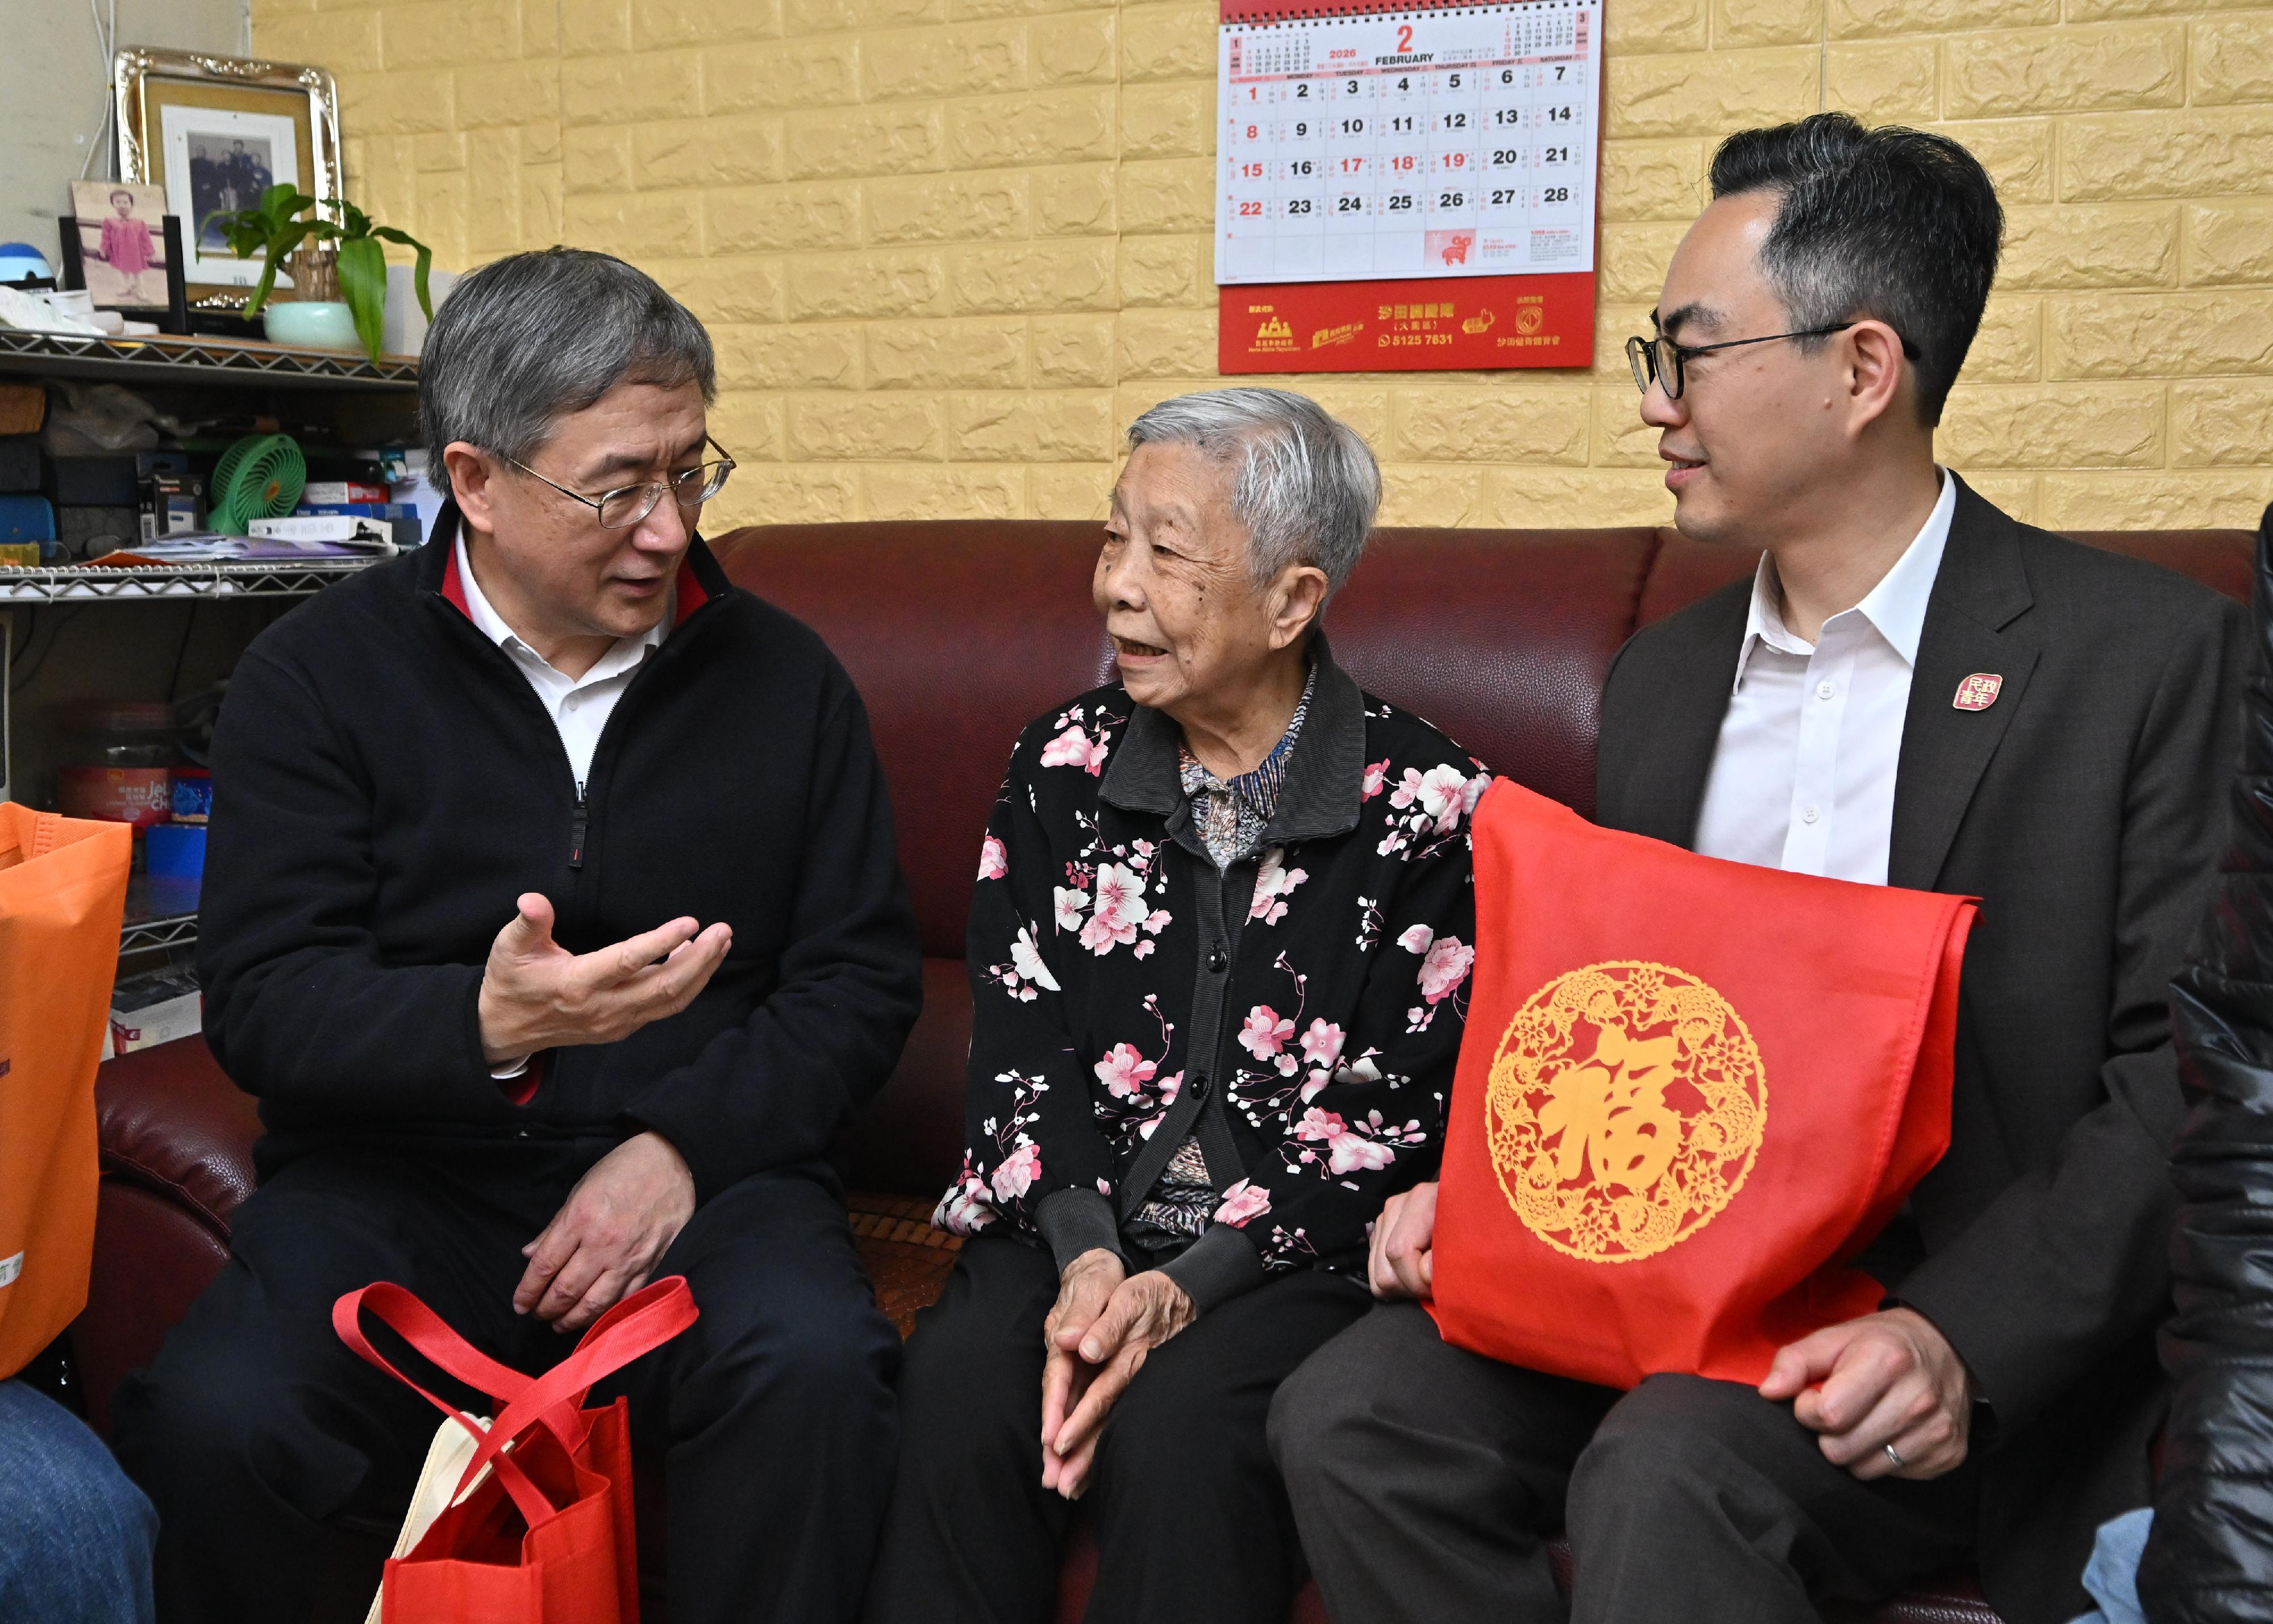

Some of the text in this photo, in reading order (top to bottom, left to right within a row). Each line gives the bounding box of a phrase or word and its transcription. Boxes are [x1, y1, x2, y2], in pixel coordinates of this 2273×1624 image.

[1397, 24, 1413, 52] 2
[1329, 49, 1356, 59] 2026
[1375, 53, 1434, 65] FEBRUARY
[1248, 66, 1566, 101] 1 2 3 4 5 6 7
[1247, 107, 1571, 139] 8 9 10 11 12 13 14
[1242, 147, 1567, 177] 15 16 17 18 19 20 21
[1240, 188, 1568, 215] 22 23 24 25 26 27 28
[1393, 335, 1422, 345] 5125
[1960, 690, 1989, 707] 青年
[1967, 677, 1997, 694] 民政
[1538, 1025, 1681, 1189] 福
